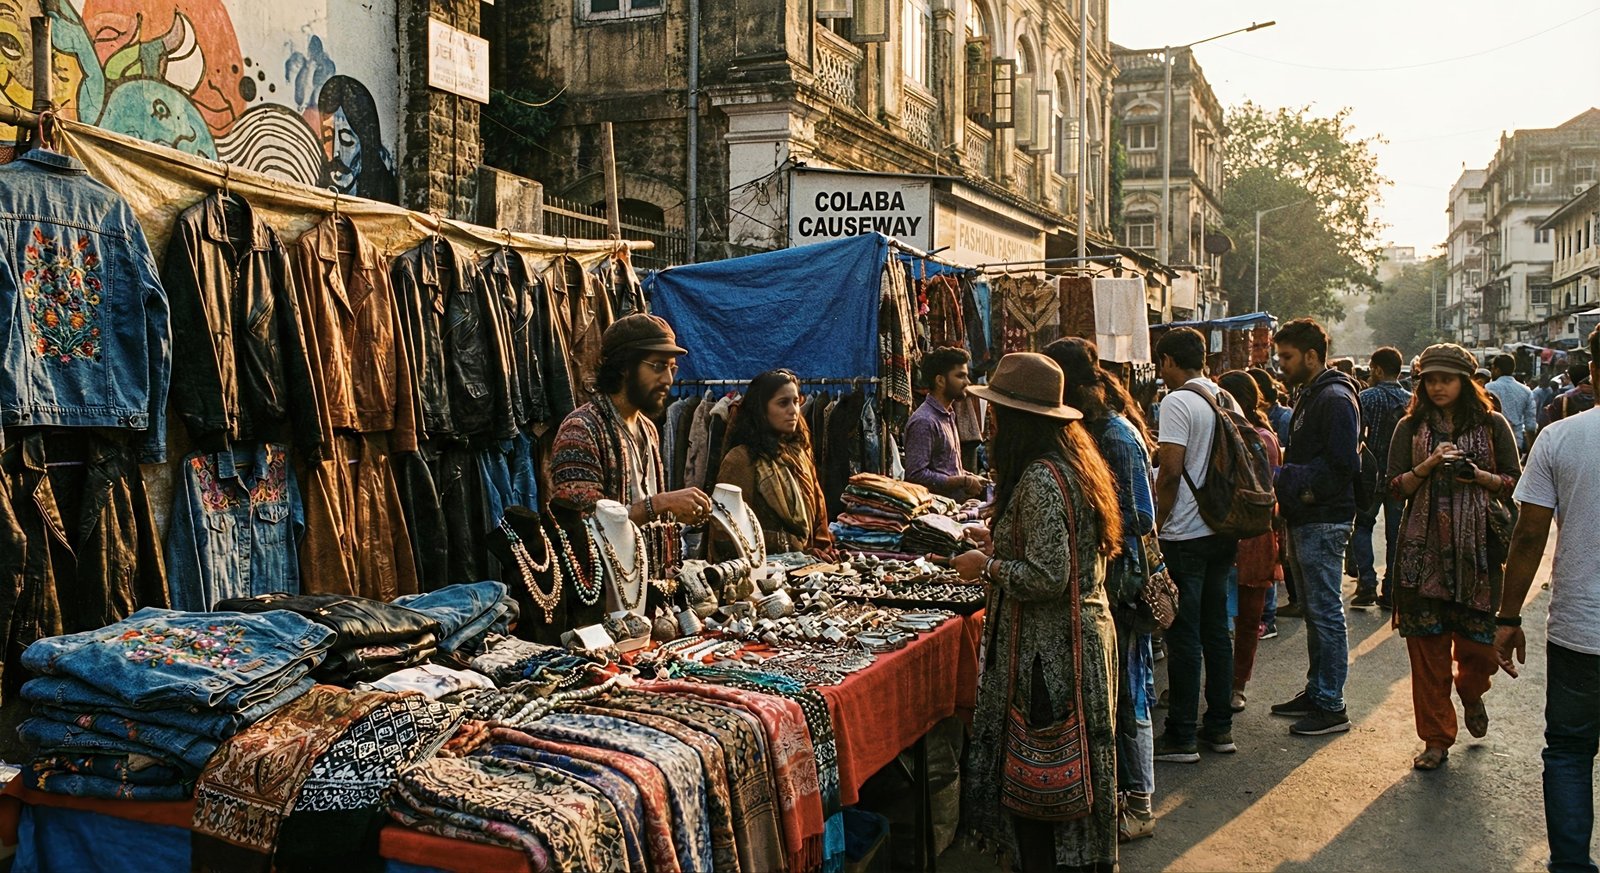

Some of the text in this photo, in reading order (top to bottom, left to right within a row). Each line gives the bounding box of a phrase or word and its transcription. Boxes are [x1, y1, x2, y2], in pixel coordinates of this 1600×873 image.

[815, 191, 905, 212] COLABA
[798, 216, 922, 237] CAUSEWAY
[959, 222, 995, 258] FASHION
